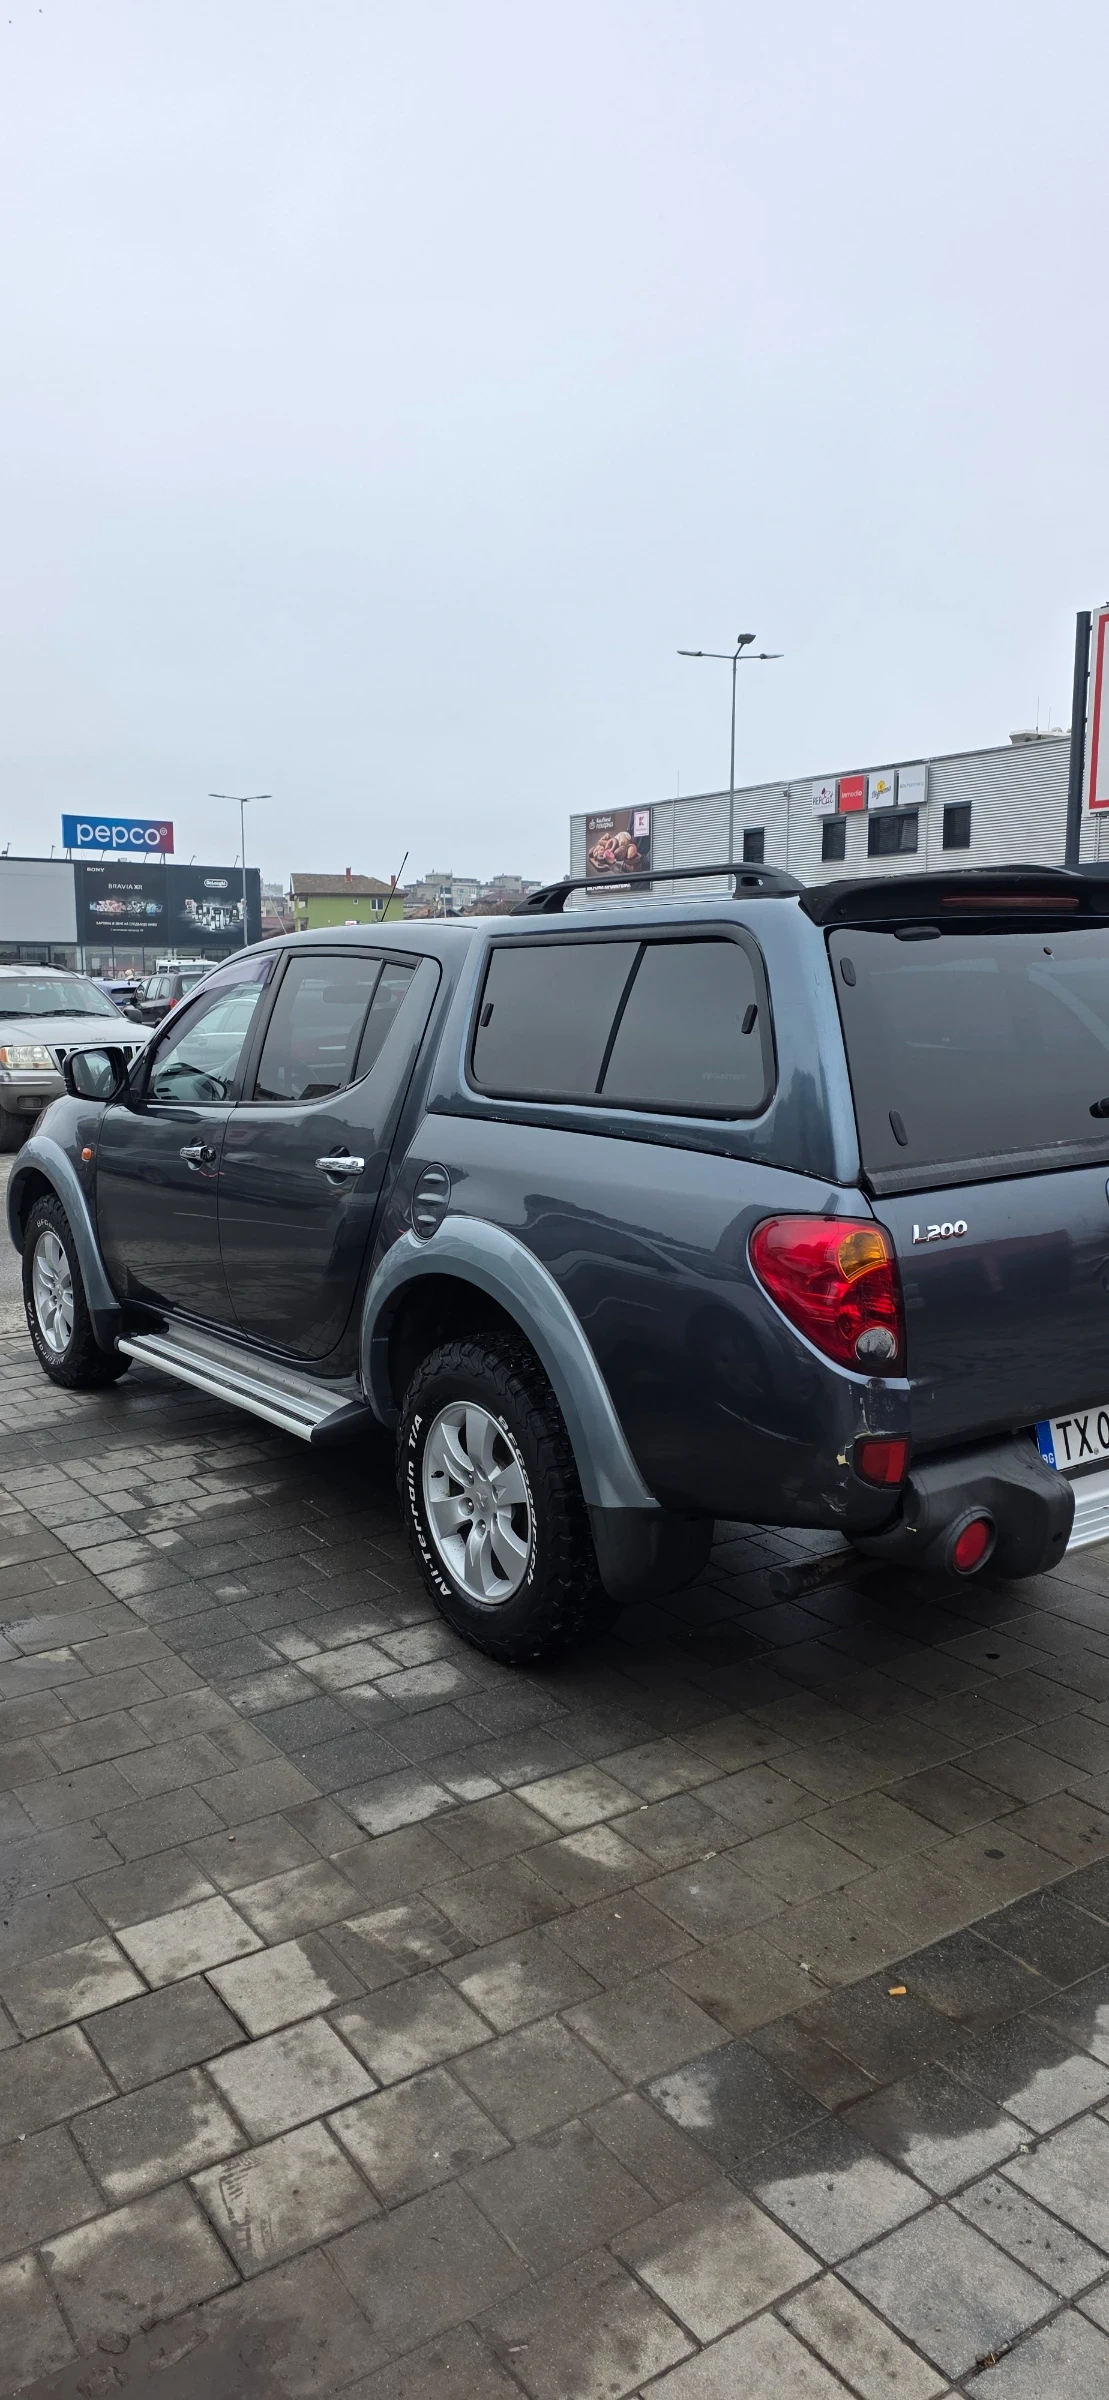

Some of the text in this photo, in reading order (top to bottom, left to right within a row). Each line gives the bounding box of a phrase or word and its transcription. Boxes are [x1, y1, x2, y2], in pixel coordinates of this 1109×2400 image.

[77, 824, 160, 847] pepco
[912, 1220, 968, 1244] L200
[407, 1414, 452, 1596] All-Terrain T/A
